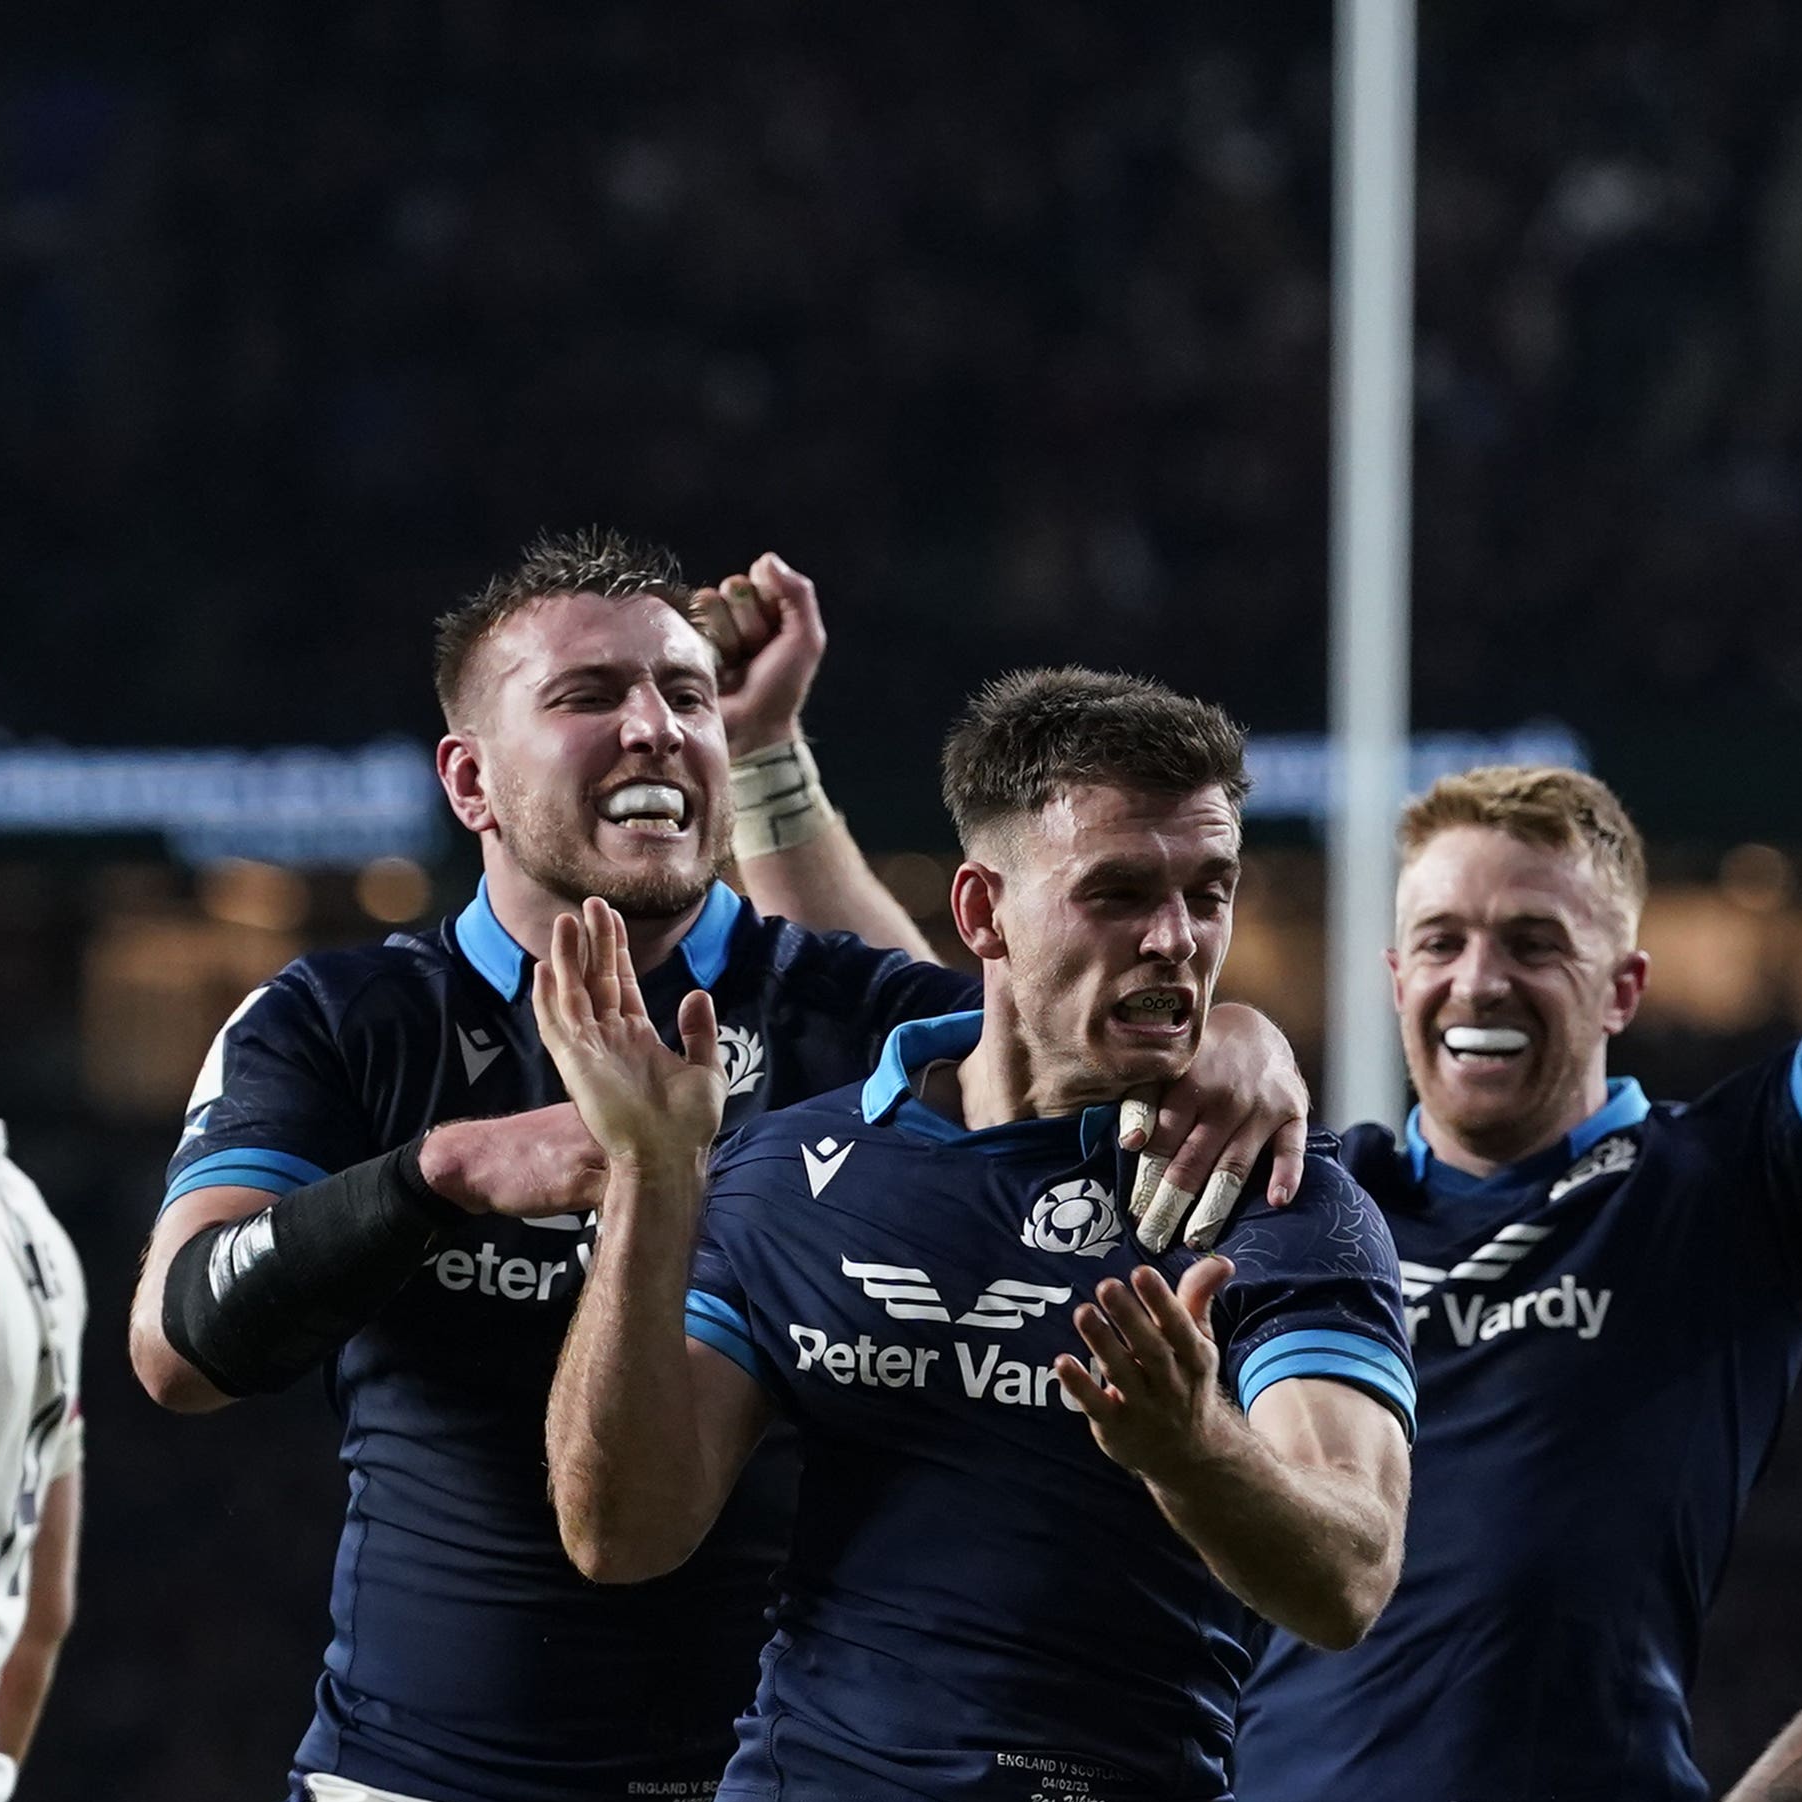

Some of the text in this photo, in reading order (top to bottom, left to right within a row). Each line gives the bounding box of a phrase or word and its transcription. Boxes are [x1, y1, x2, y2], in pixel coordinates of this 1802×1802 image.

[421, 1241, 568, 1302] eter
[1442, 1273, 1613, 1347] Vardy
[788, 1322, 1103, 1413] Peter Var
[996, 1753, 1057, 1773] ENGLAND
[1060, 1761, 1069, 1774] V
[627, 1781, 688, 1795] ENGLAND
[690, 1781, 700, 1794] V
[1041, 1776, 1090, 1793] 04/02/23
